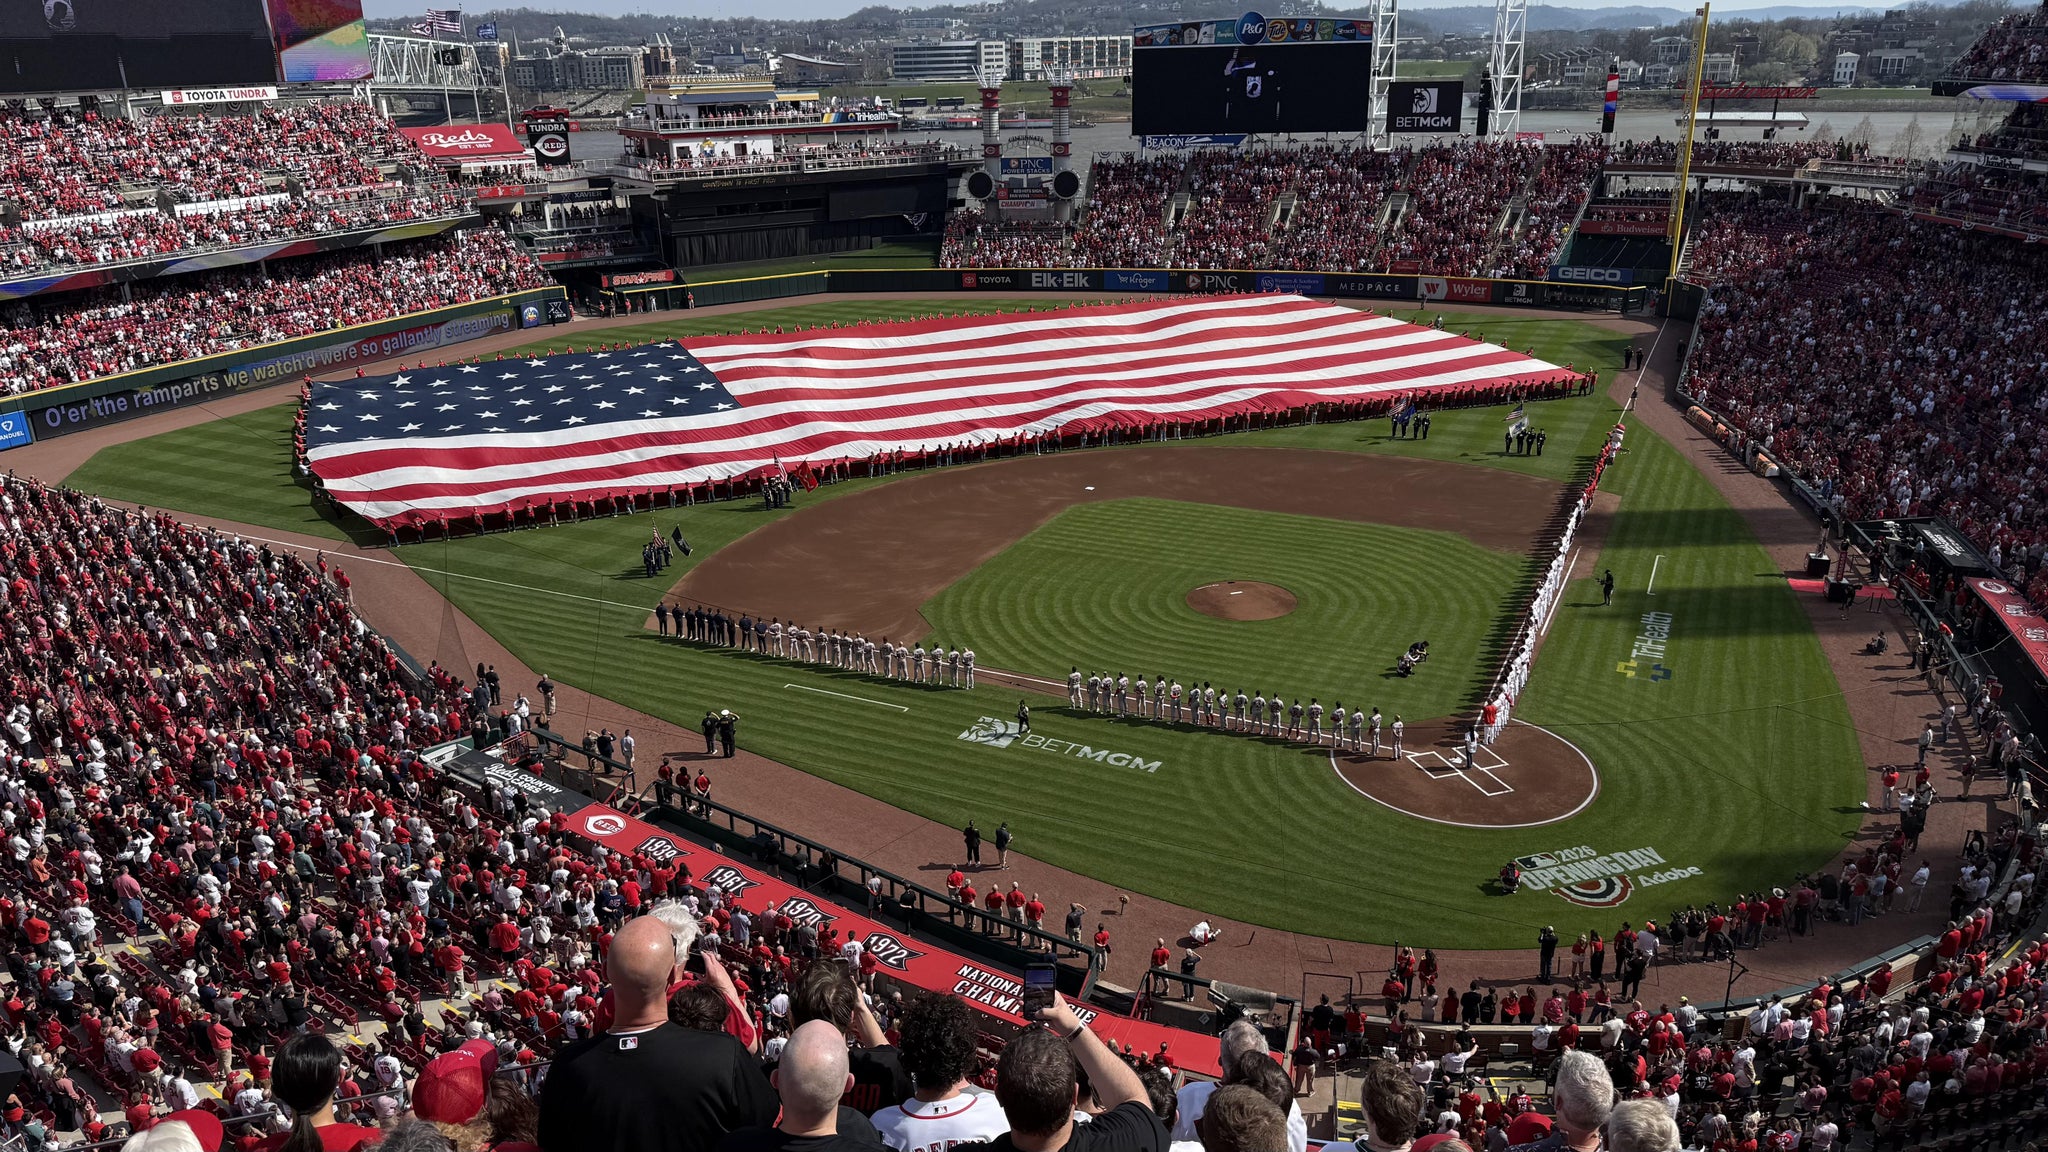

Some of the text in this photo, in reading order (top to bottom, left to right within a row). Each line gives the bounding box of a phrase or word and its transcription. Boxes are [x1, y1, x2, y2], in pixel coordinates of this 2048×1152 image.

[1241, 23, 1263, 35] P&G
[1268, 20, 1287, 38] Tide
[186, 88, 269, 102] TOYOTA TUNDRA
[855, 112, 889, 122] TriHealth
[1396, 116, 1452, 127] BETMGM
[529, 124, 567, 132] TUNDRA
[421, 129, 494, 148] Reds
[543, 141, 567, 150] REDS
[1146, 136, 1185, 147] BEACON
[1020, 159, 1044, 169] PNC
[1617, 225, 1665, 234] Budweiser
[979, 276, 1011, 284] TOYOTA
[1031, 272, 1090, 288] Elk+Elk
[1130, 273, 1156, 288] Kroger
[1558, 267, 1622, 281] GEICO
[1204, 275, 1238, 289] PNC
[1339, 281, 1400, 292] MEDPACE
[1452, 284, 1487, 297] Wyler
[45, 311, 509, 428] O'er the ramparts we watch'd were so gallantly streaming
[0, 430, 24, 441] ANDUEL
[1631, 611, 1673, 659] TriHealth
[1020, 734, 1164, 773] BETMGM
[484, 763, 519, 781] Reds
[511, 778, 542, 794] CARES
[519, 773, 563, 794] COUNTRY
[596, 819, 624, 834] REDS
[640, 837, 677, 861] 1939
[1554, 845, 1598, 862] 2026
[1520, 846, 1667, 891] OPENING DAY
[711, 867, 748, 893] 1961
[1636, 865, 1704, 888] Adobe
[786, 899, 822, 925] 1970
[868, 934, 908, 964] 1972
[958, 965, 1097, 1024] NATIONA GUE
